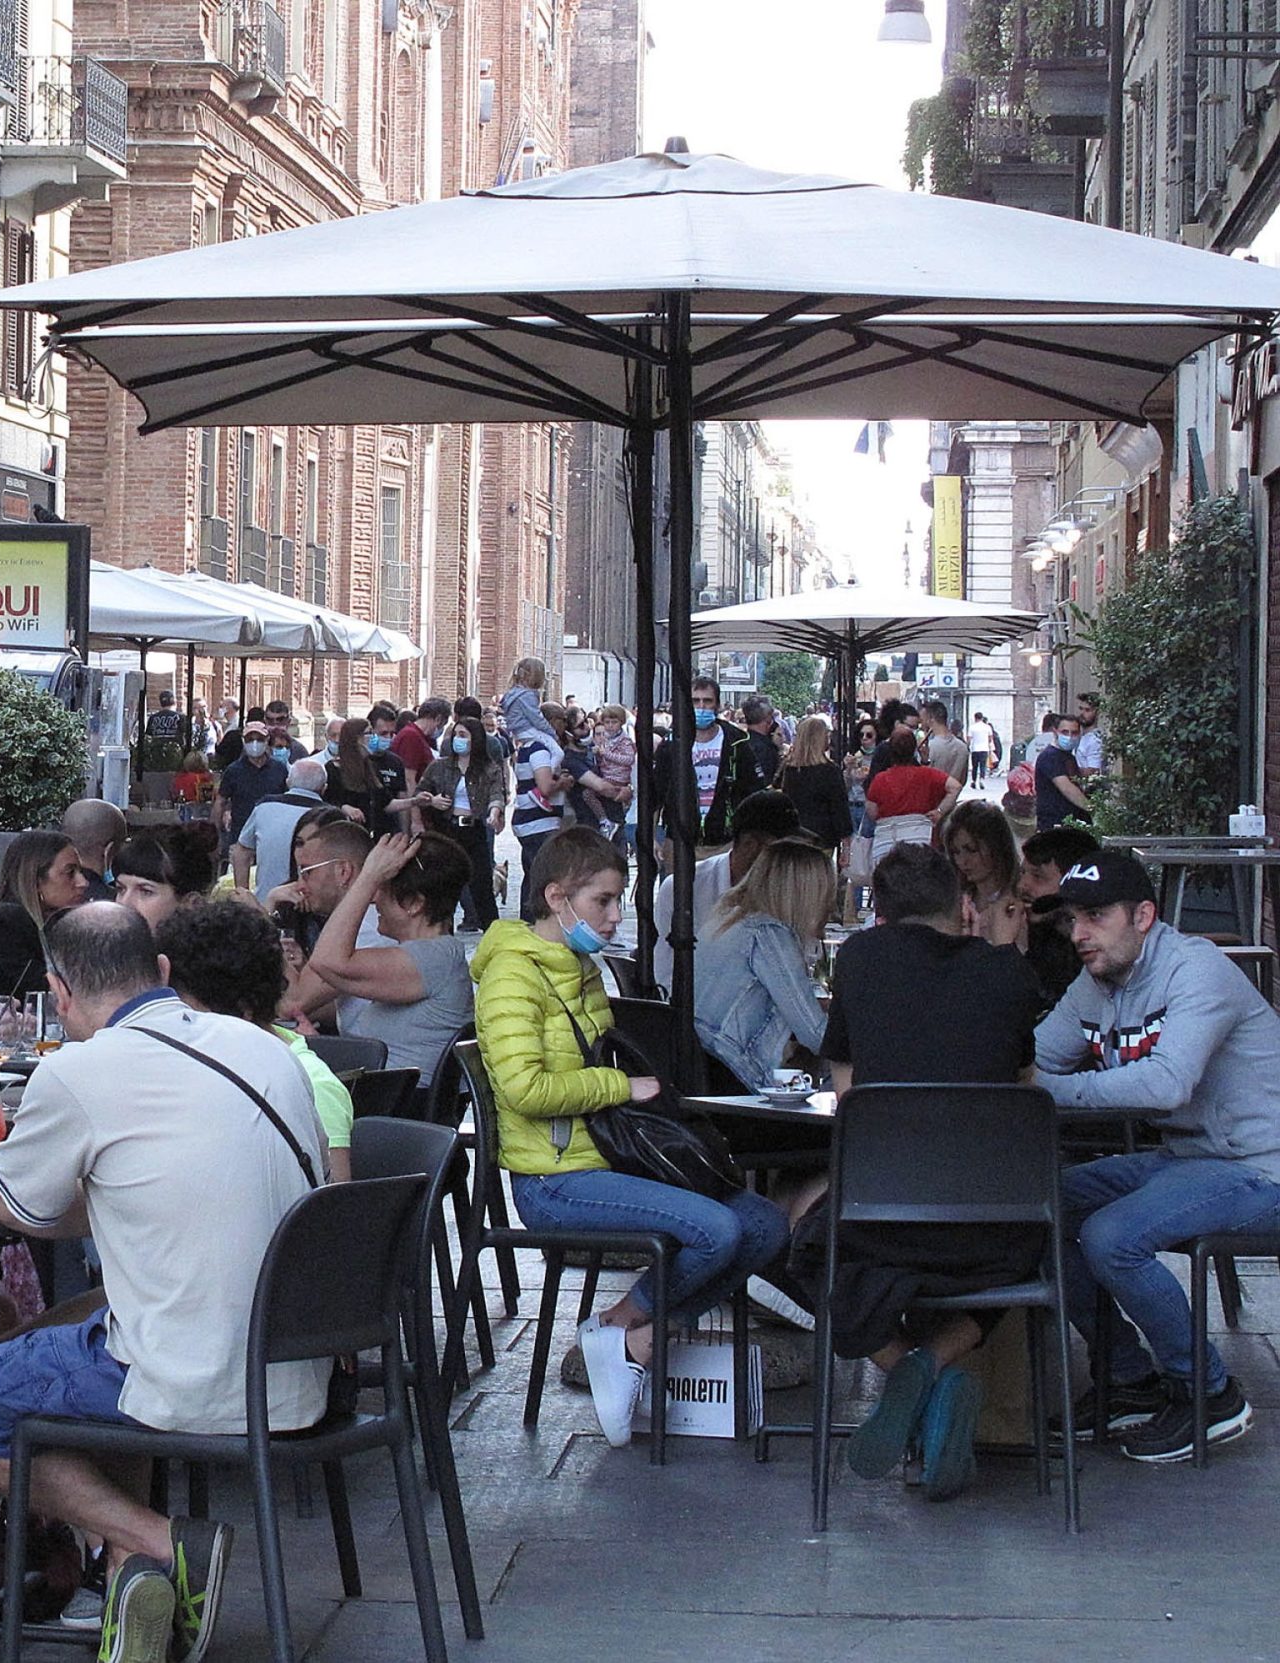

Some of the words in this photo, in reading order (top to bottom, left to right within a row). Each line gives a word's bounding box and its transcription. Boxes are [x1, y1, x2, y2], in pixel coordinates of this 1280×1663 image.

[937, 545, 949, 592] MUSEO
[949, 545, 961, 592] EGIZIO
[8, 618, 39, 632] WiFi
